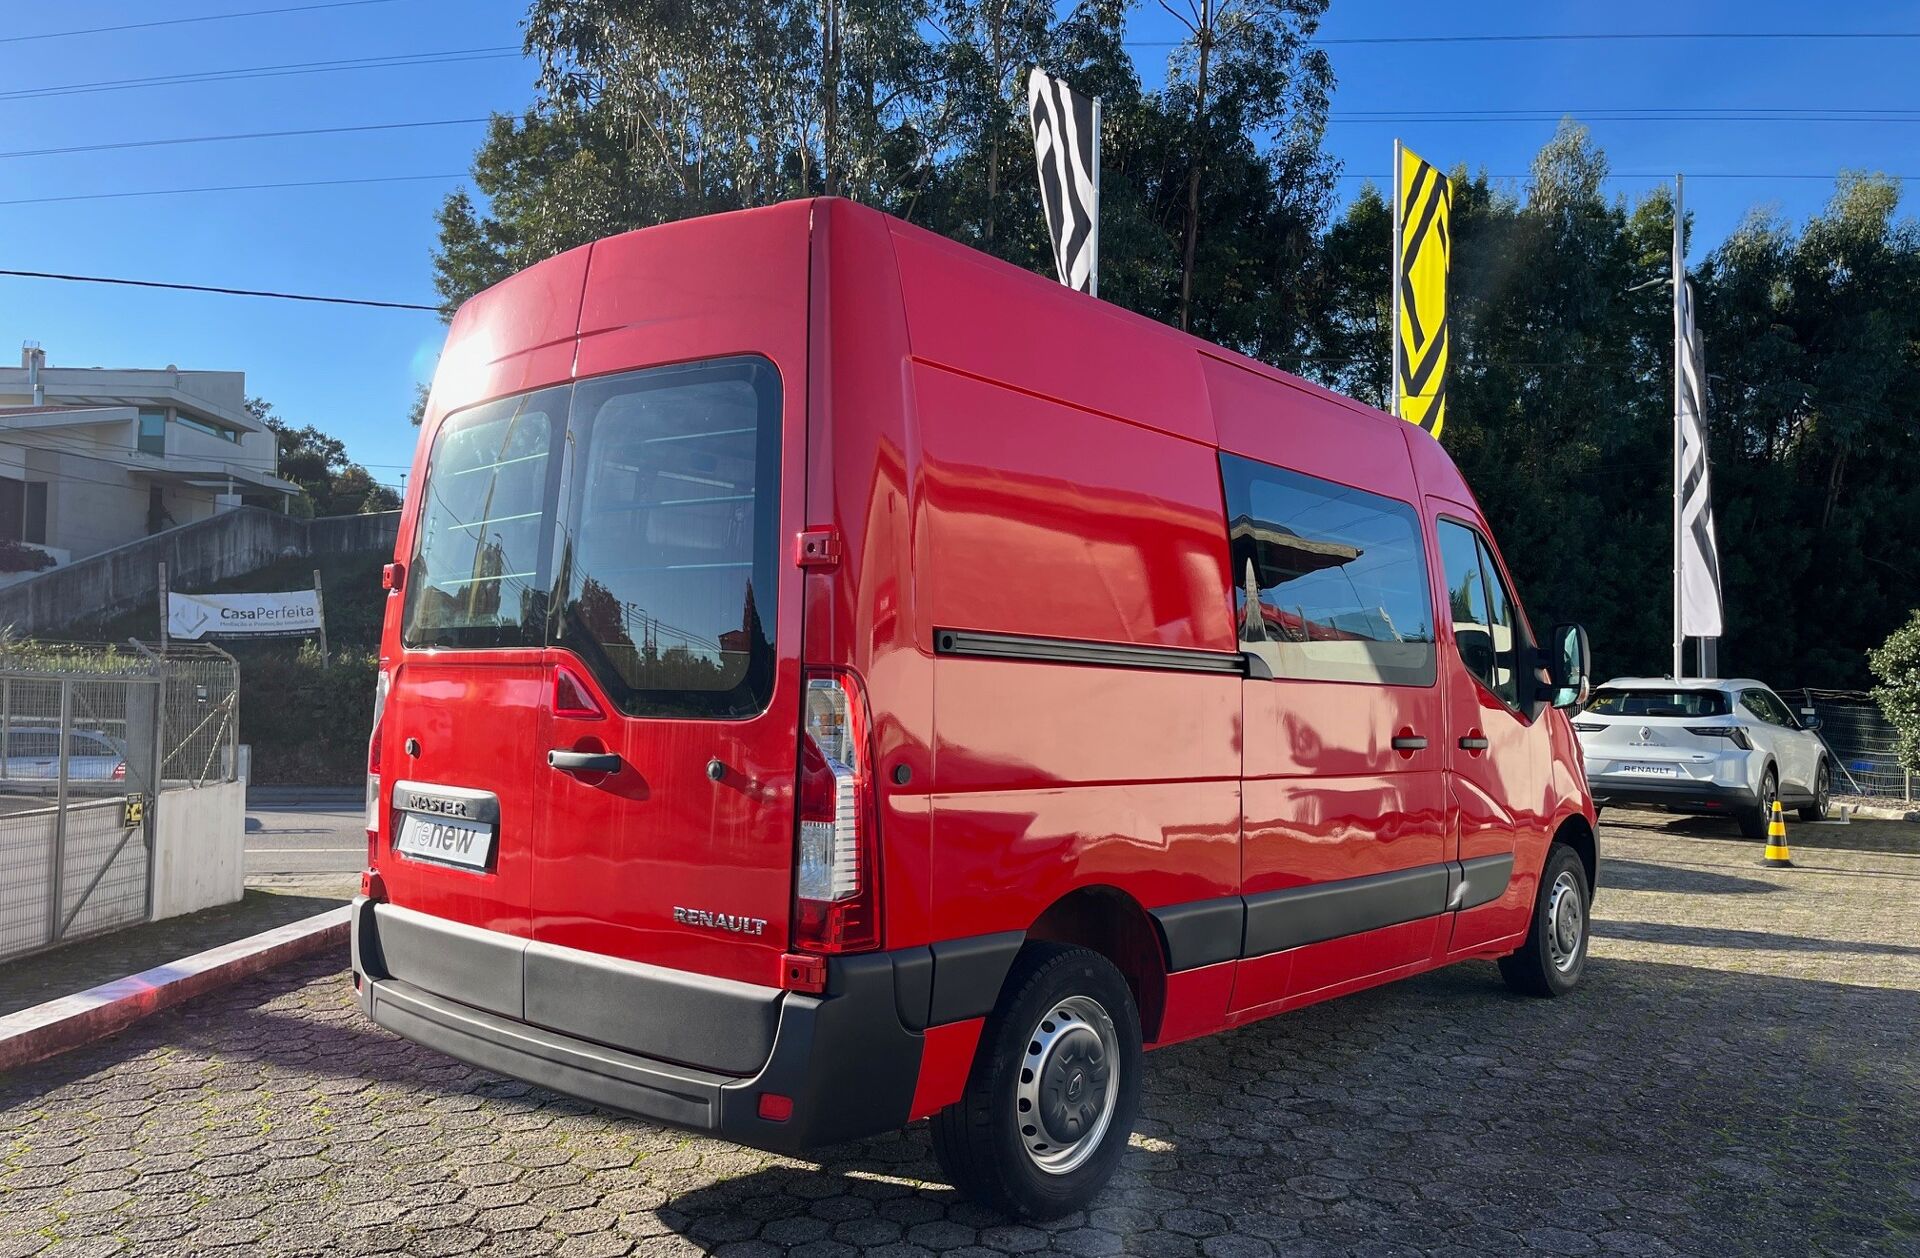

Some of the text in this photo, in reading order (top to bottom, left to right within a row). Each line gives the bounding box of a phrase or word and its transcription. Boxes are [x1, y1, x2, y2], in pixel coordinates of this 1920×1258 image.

[221, 605, 314, 620] CasaPerfeita
[1624, 765, 1671, 774] RENAULT
[409, 794, 467, 816] MASTER
[410, 821, 477, 854] renew
[673, 906, 767, 936] RENAULT
